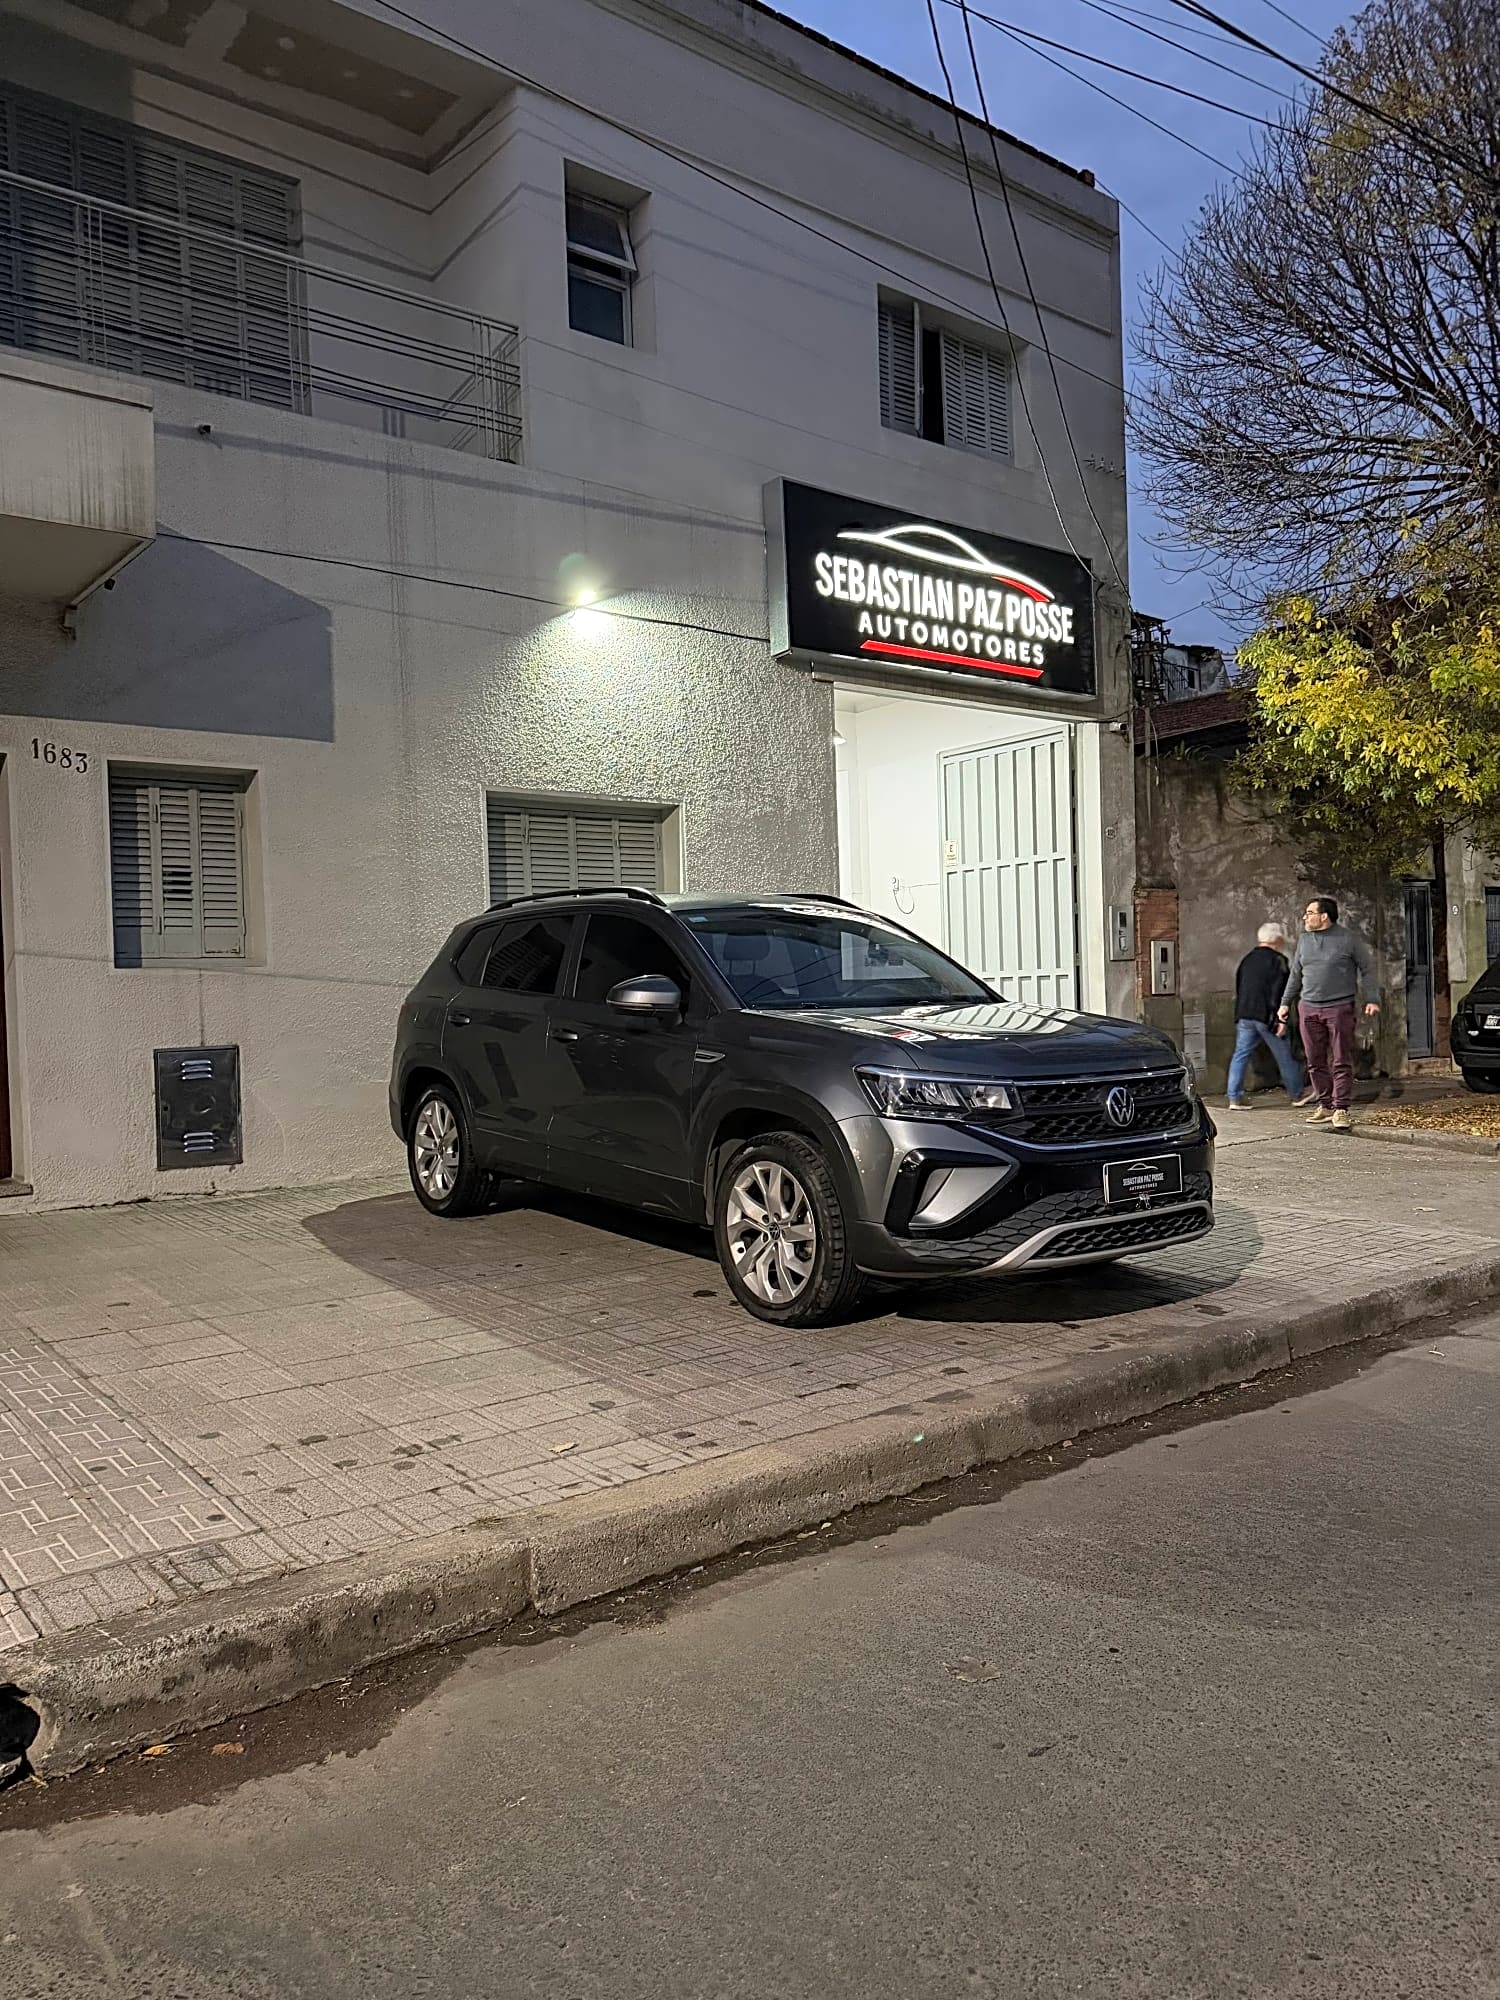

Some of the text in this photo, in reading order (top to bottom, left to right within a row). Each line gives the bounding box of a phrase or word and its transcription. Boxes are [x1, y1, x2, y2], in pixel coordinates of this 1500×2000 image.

[815, 552, 1075, 645] SEBASTIAN PAZ POSSE
[858, 610, 1044, 666] AUTOMOTORES
[31, 738, 88, 774] 1683
